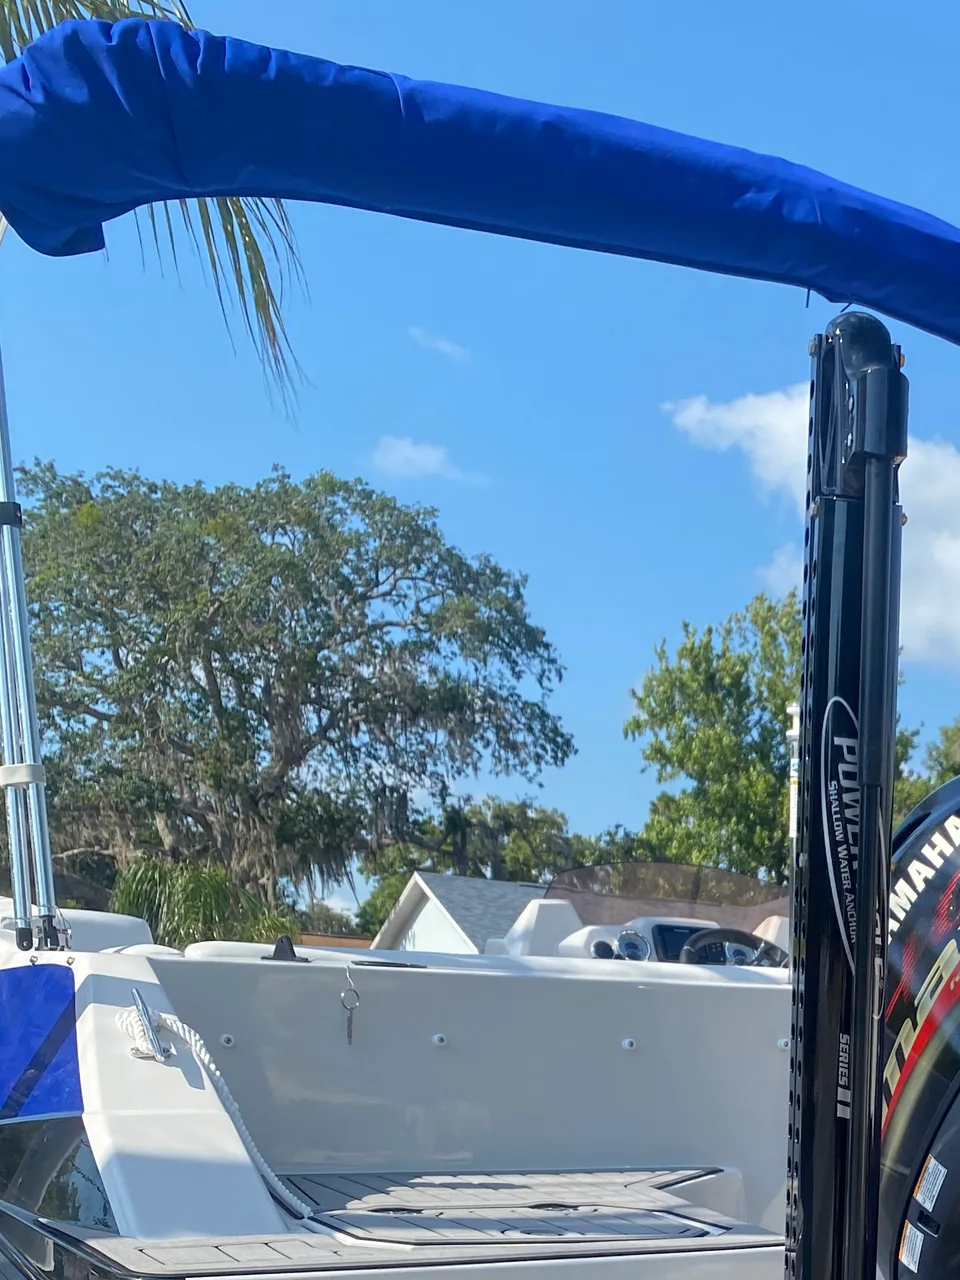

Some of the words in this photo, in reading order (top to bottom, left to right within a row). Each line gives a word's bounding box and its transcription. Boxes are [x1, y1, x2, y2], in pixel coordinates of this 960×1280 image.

[827, 780, 845, 842] SHALLOW
[837, 844, 853, 889] WATER
[838, 1032, 851, 1086] SERIES
